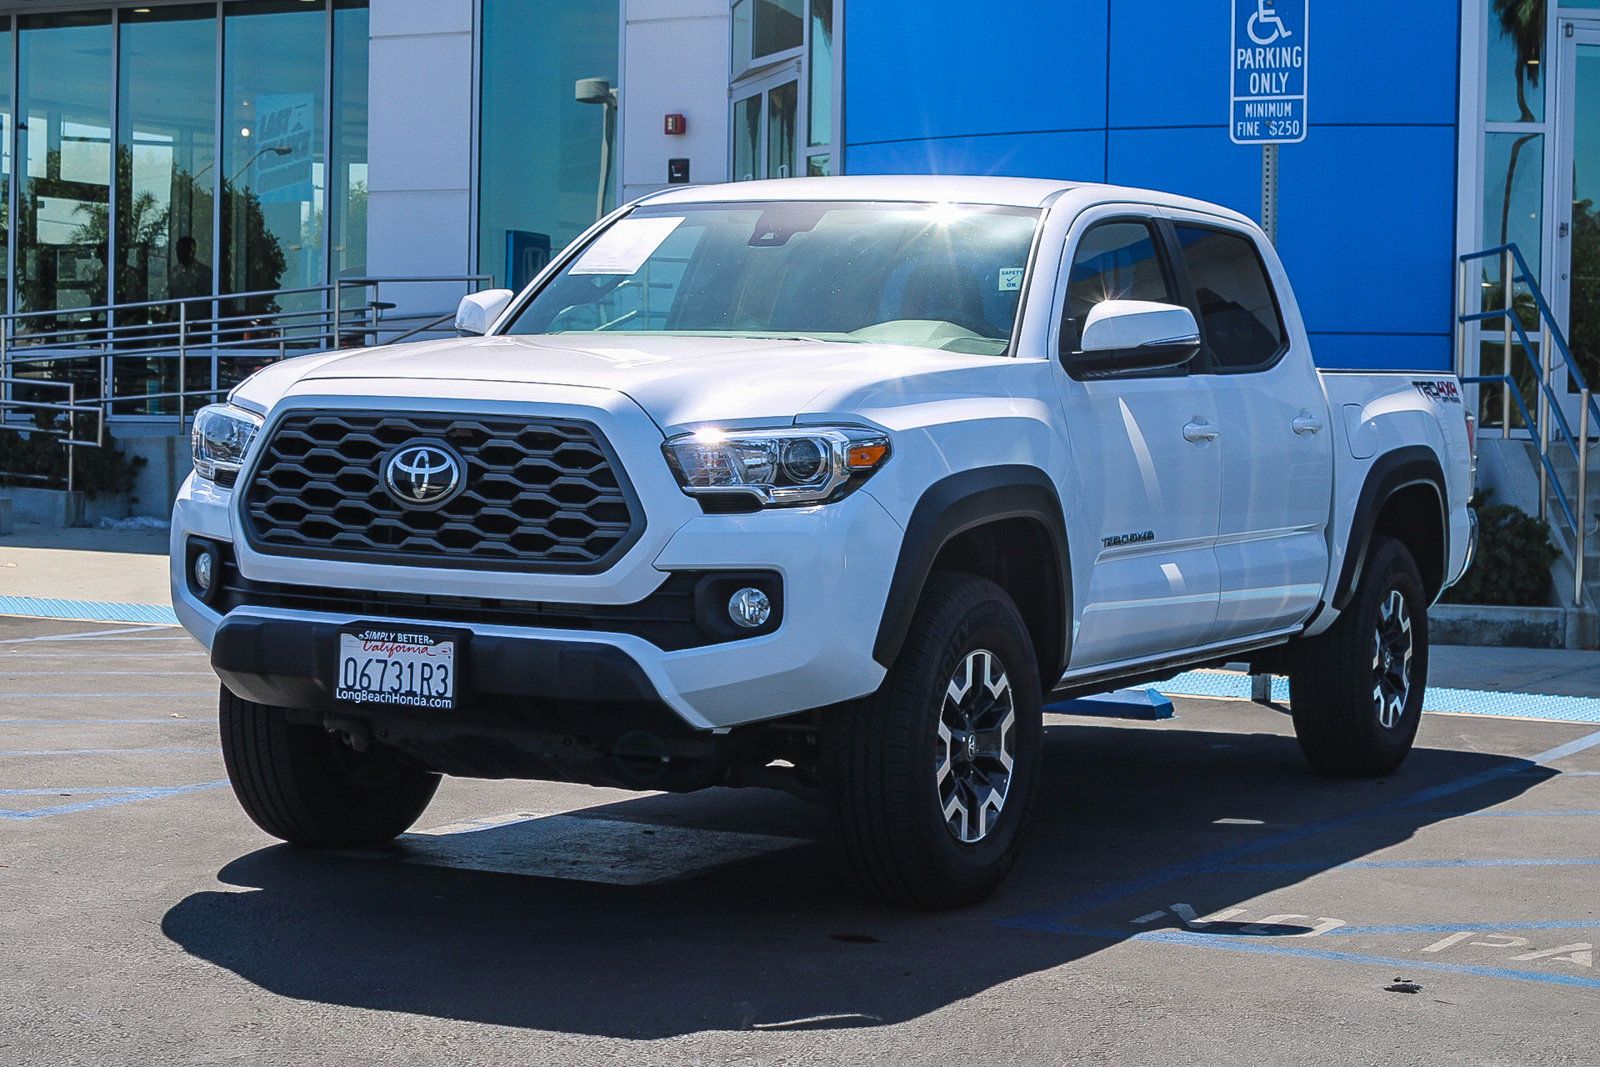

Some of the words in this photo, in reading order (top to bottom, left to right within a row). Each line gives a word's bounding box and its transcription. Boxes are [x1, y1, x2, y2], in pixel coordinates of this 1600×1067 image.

[1237, 46, 1302, 69] PARKING
[1249, 72, 1289, 94] ONLY
[1245, 102, 1292, 118] MINIMUM
[1237, 121, 1260, 136] FINE
[1269, 120, 1300, 136] $250
[1102, 530, 1155, 548] TACOMA
[364, 631, 396, 642] SIMPLY
[397, 633, 429, 645] BETTER
[362, 640, 437, 658] California
[344, 656, 449, 698] 06731R3
[336, 688, 452, 709] LongBeachHonda.com
